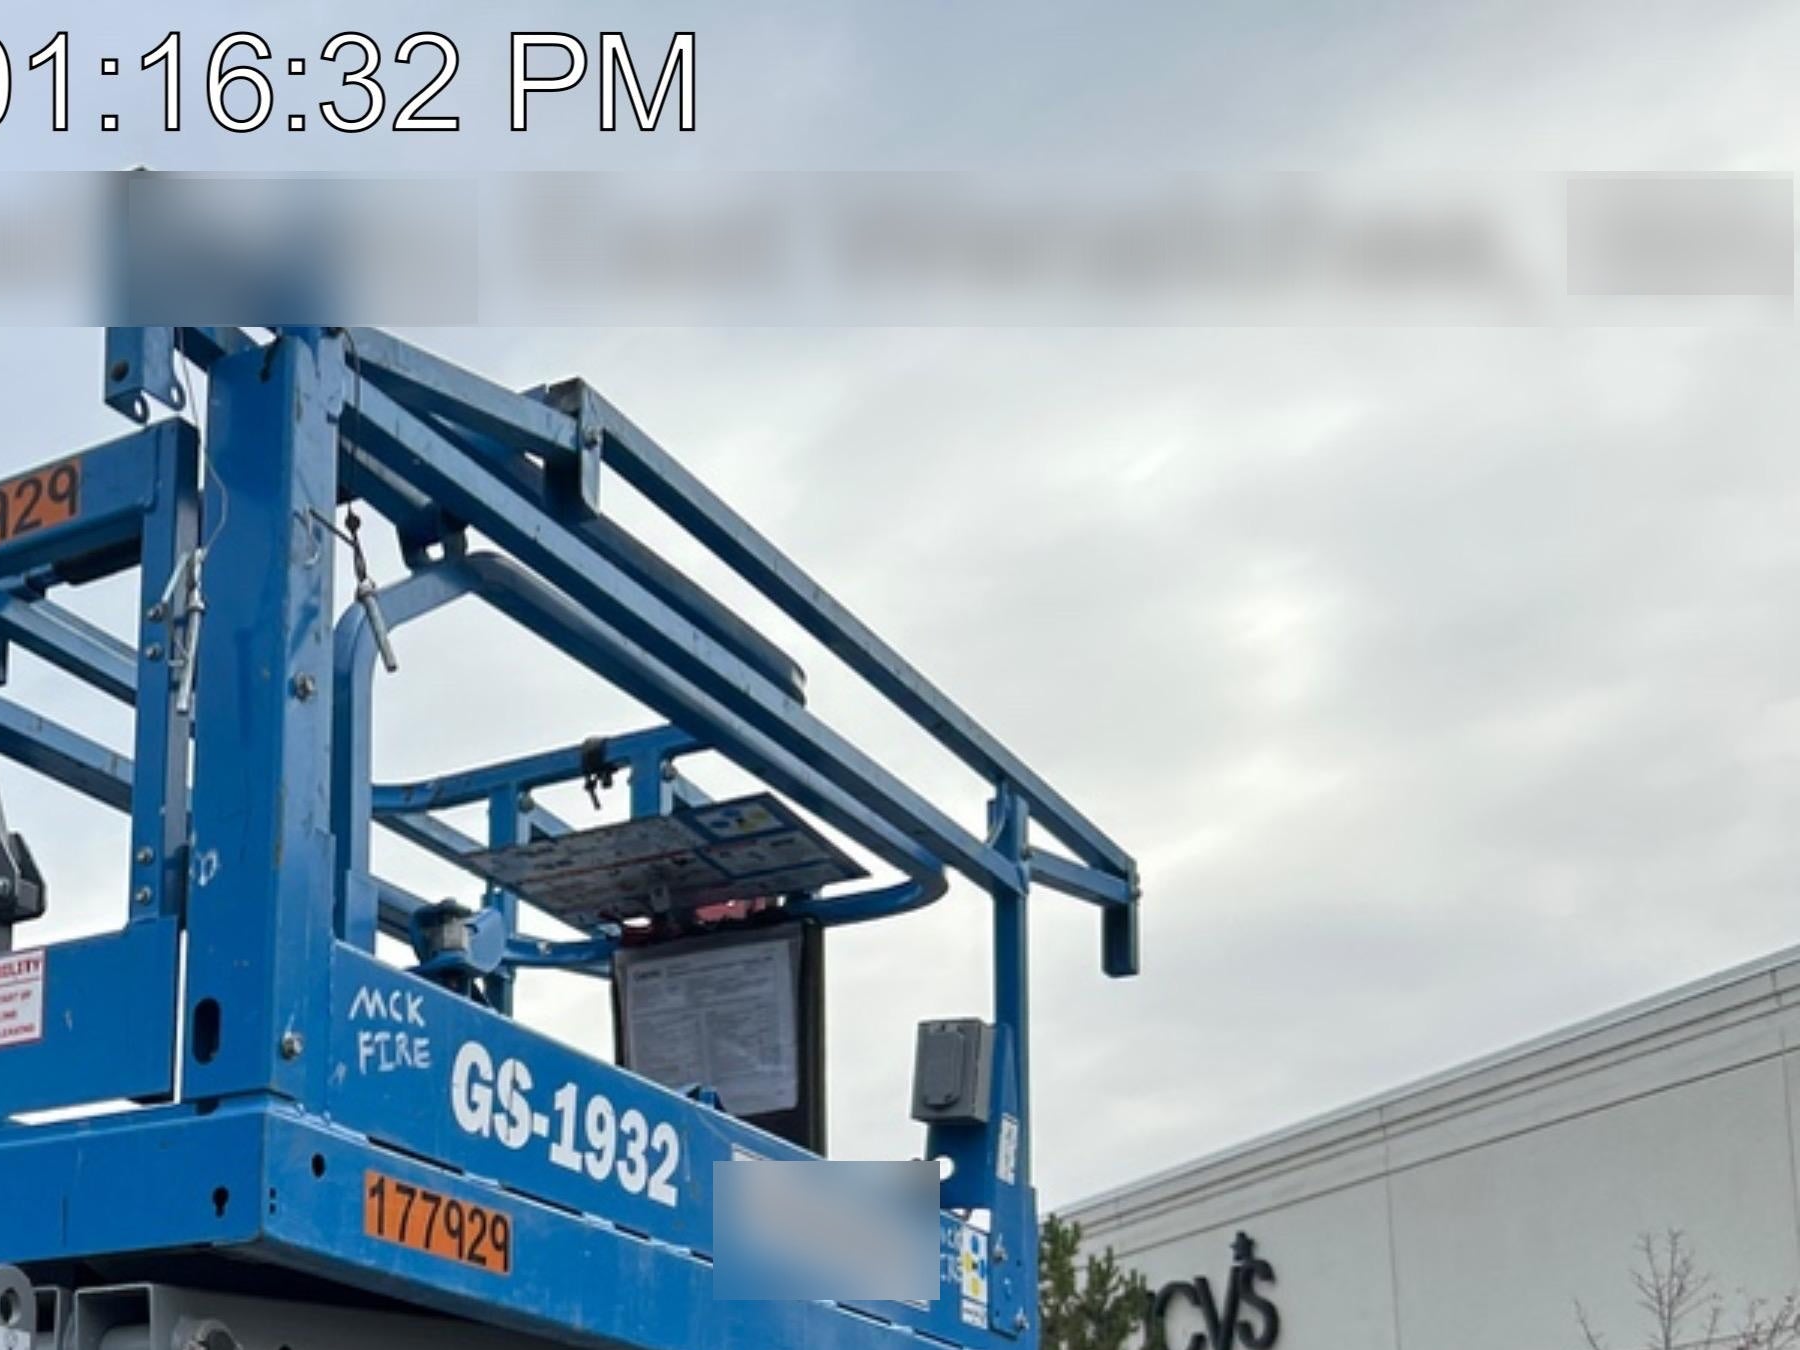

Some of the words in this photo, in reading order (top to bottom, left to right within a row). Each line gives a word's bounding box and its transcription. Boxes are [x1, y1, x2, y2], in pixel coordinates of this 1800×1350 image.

[348, 985, 426, 1028] MCK
[357, 1030, 433, 1076] FIRE
[450, 1039, 681, 1209] GS-1932
[368, 1174, 511, 1274] 177929
